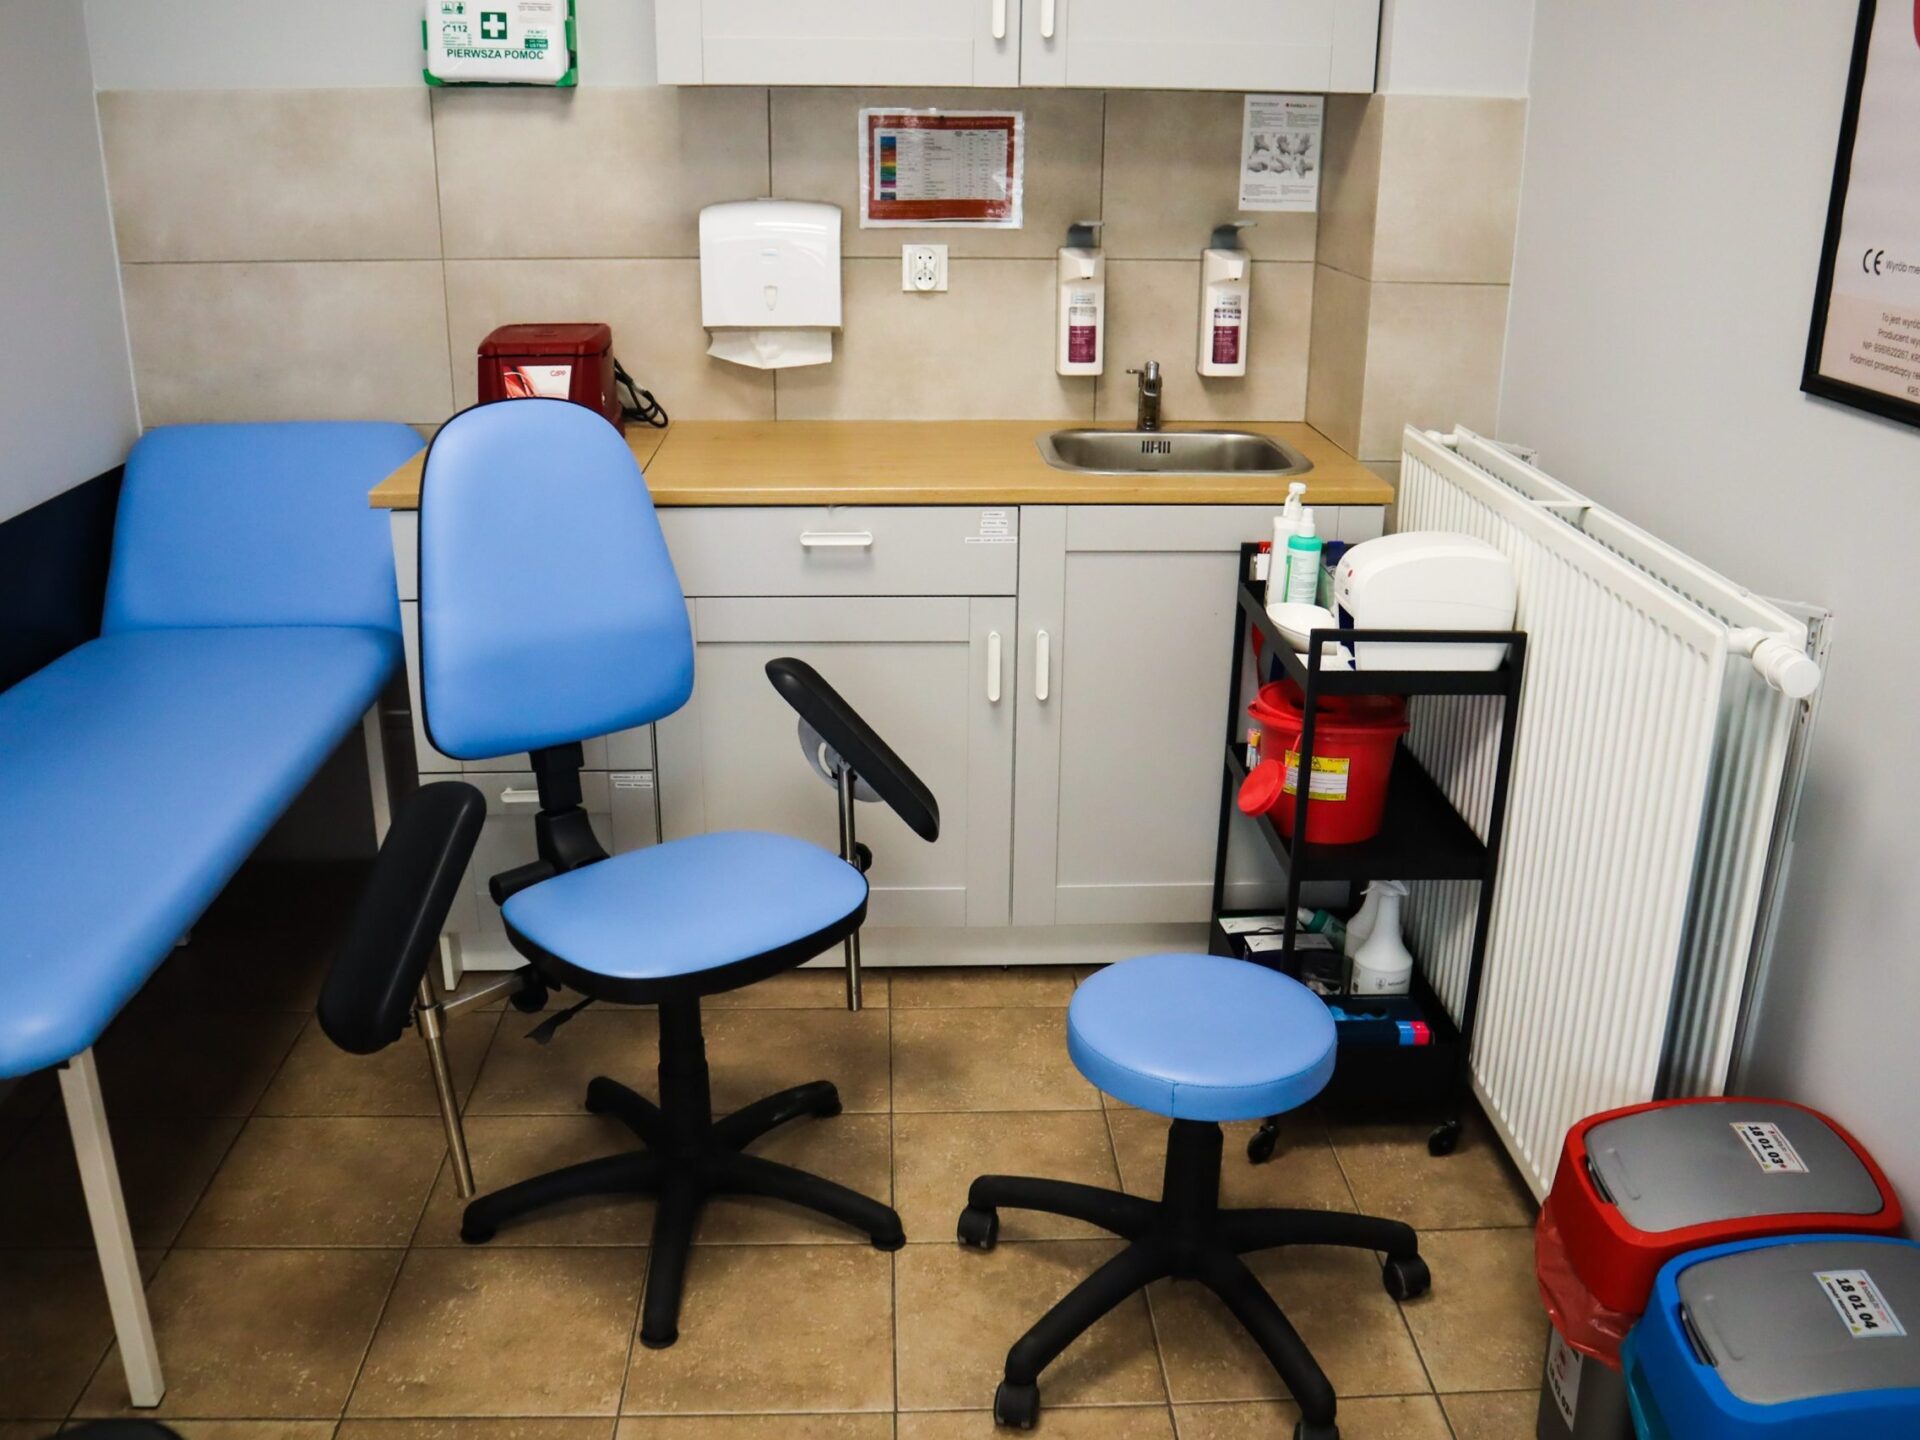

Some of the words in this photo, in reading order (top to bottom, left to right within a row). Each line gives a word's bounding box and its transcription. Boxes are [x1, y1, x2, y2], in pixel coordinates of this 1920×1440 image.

[452, 24, 468, 33] 112
[446, 48, 502, 59] PIERWSZA
[504, 50, 544, 60] POMOC
[1747, 1125, 1765, 1137] 18
[1758, 1138, 1774, 1150] 01
[1836, 1277, 1856, 1293] 18
[1847, 1294, 1866, 1310] 01
[1859, 1312, 1879, 1330] 04
